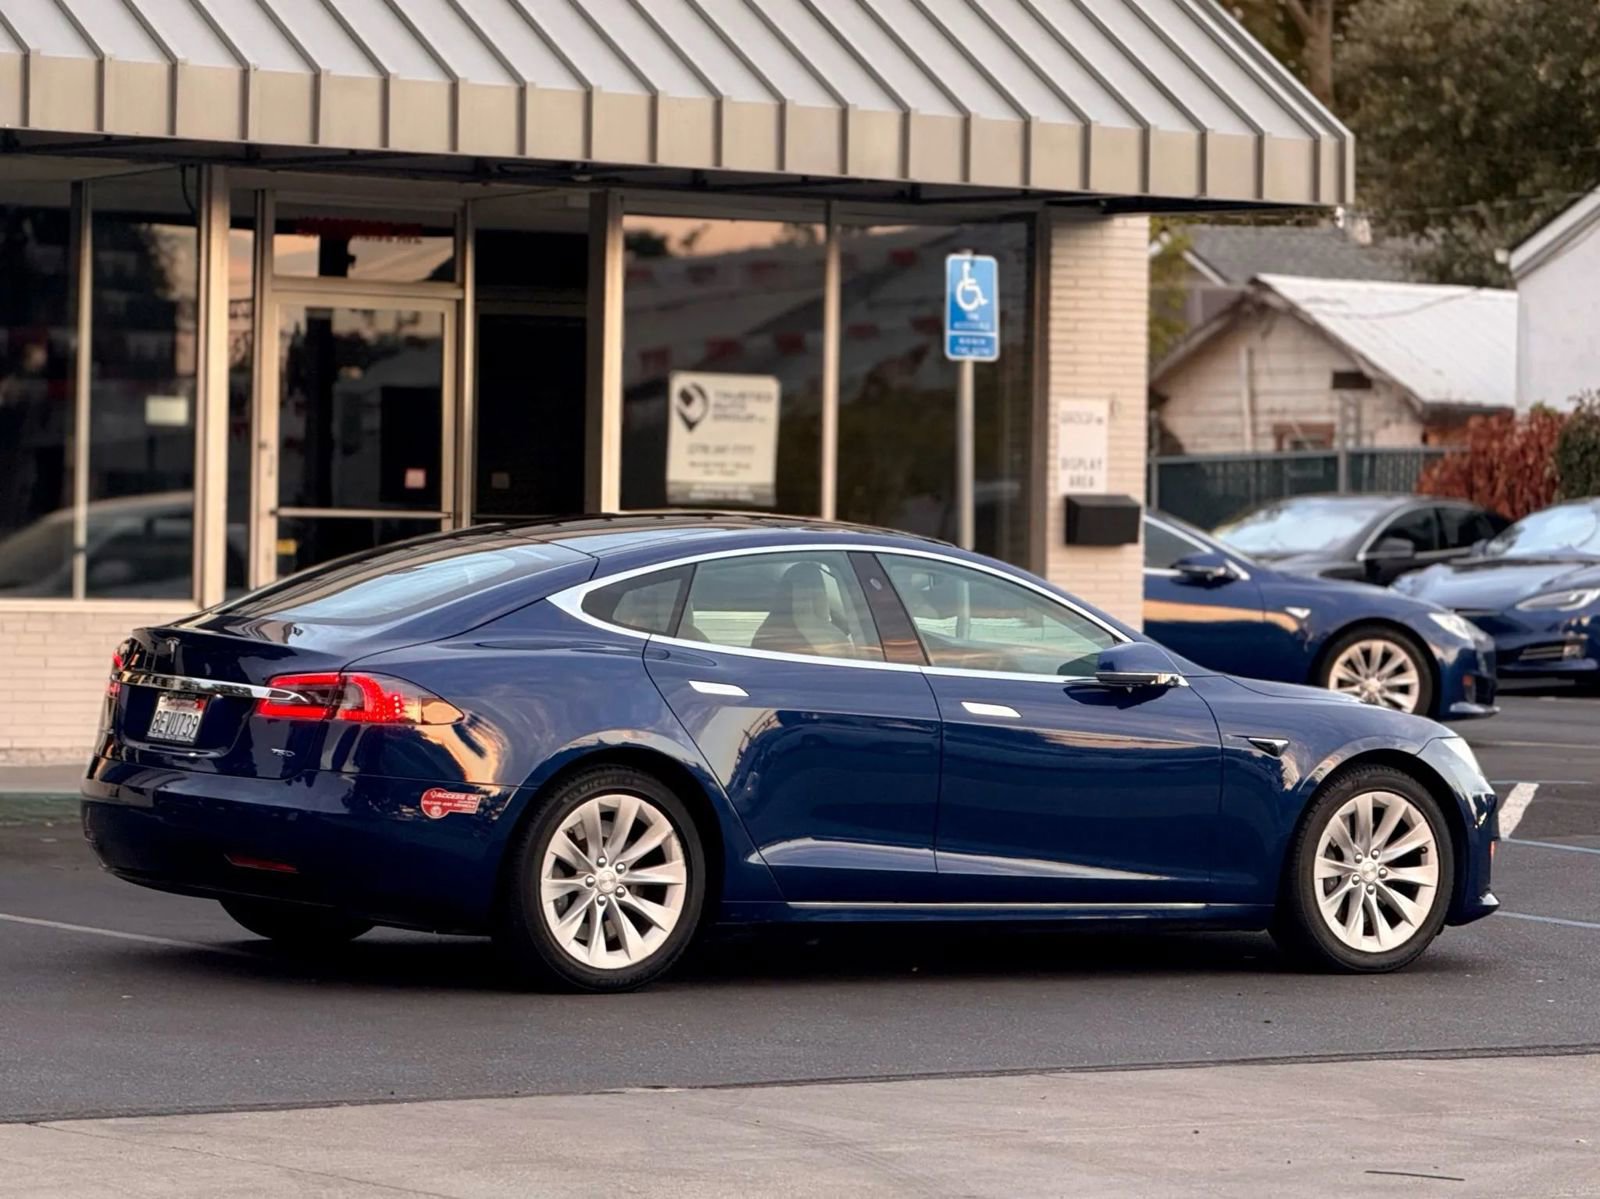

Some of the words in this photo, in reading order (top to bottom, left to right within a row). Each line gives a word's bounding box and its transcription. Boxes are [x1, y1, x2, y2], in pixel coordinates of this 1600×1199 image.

[1061, 457, 1103, 470] DISPLAY
[1069, 475, 1095, 488] AREA
[151, 710, 199, 739] 8EVU739
[436, 792, 466, 800] ACCESS
